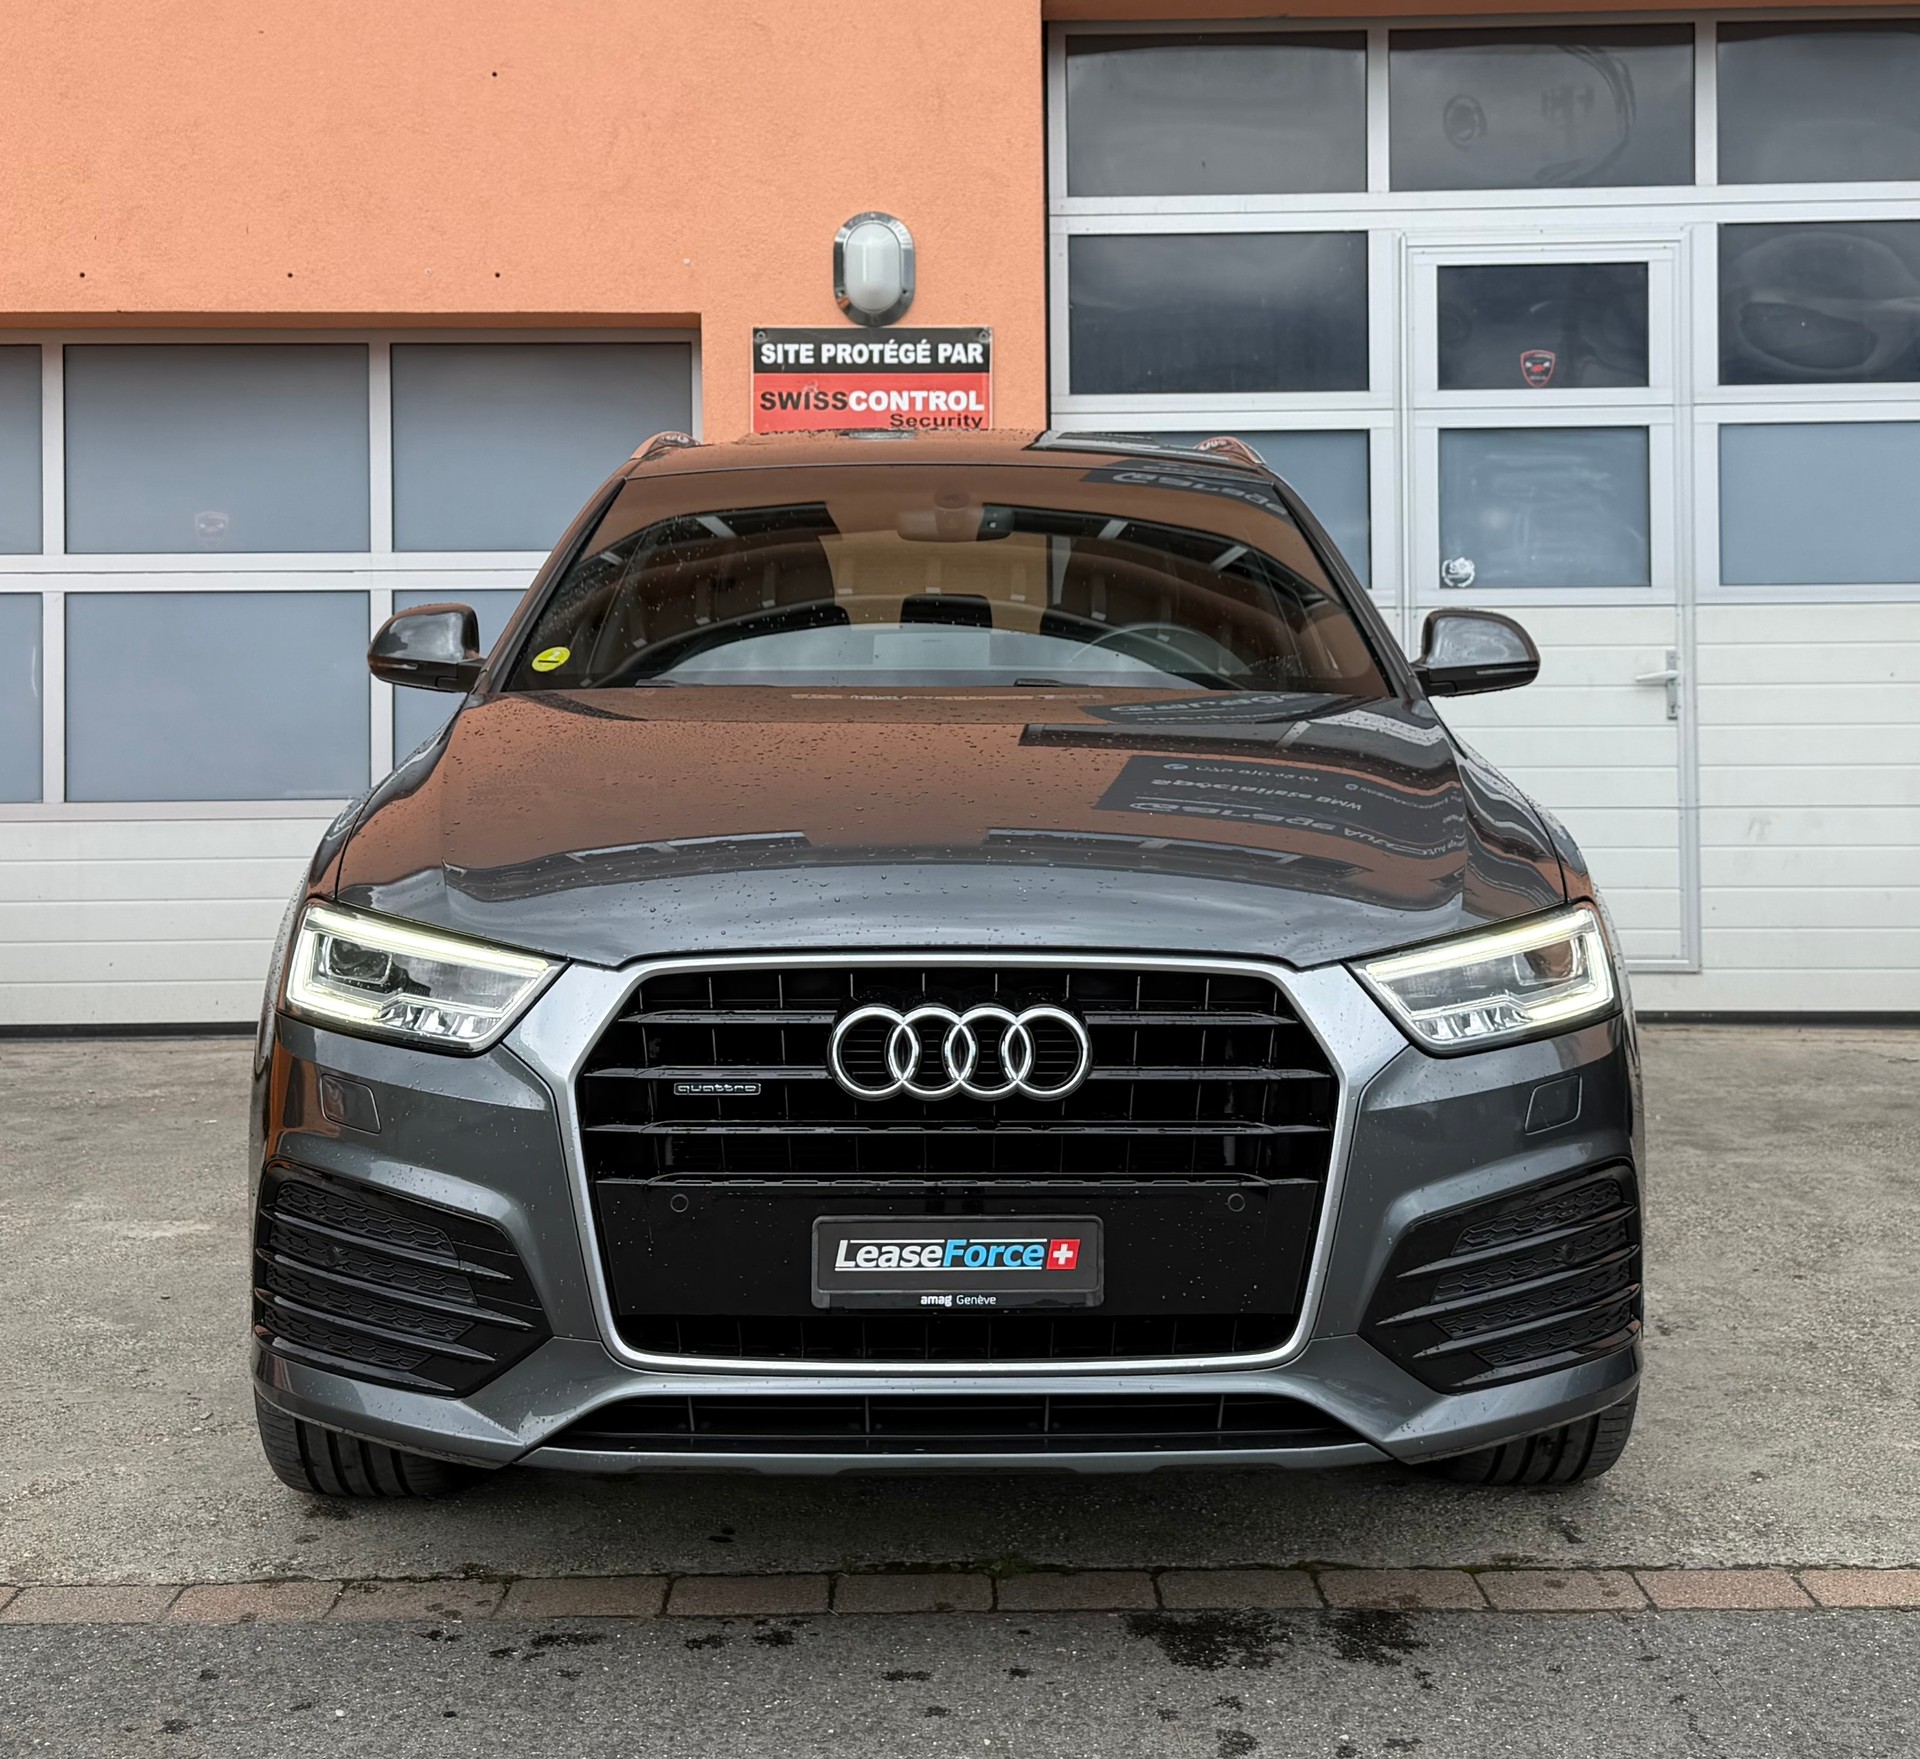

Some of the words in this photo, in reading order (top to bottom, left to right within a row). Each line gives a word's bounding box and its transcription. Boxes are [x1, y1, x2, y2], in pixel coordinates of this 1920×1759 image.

[760, 342, 815, 365] SITE
[821, 338, 932, 365] PROTÉGÉ
[937, 342, 984, 364] PAR
[760, 389, 985, 412] SWISSCONTROL
[889, 413, 984, 429] Security
[677, 1084, 757, 1094] quattro
[835, 1239, 1045, 1267] LeaseForce
[920, 1295, 952, 1307] amag
[956, 1294, 997, 1305] Genève
